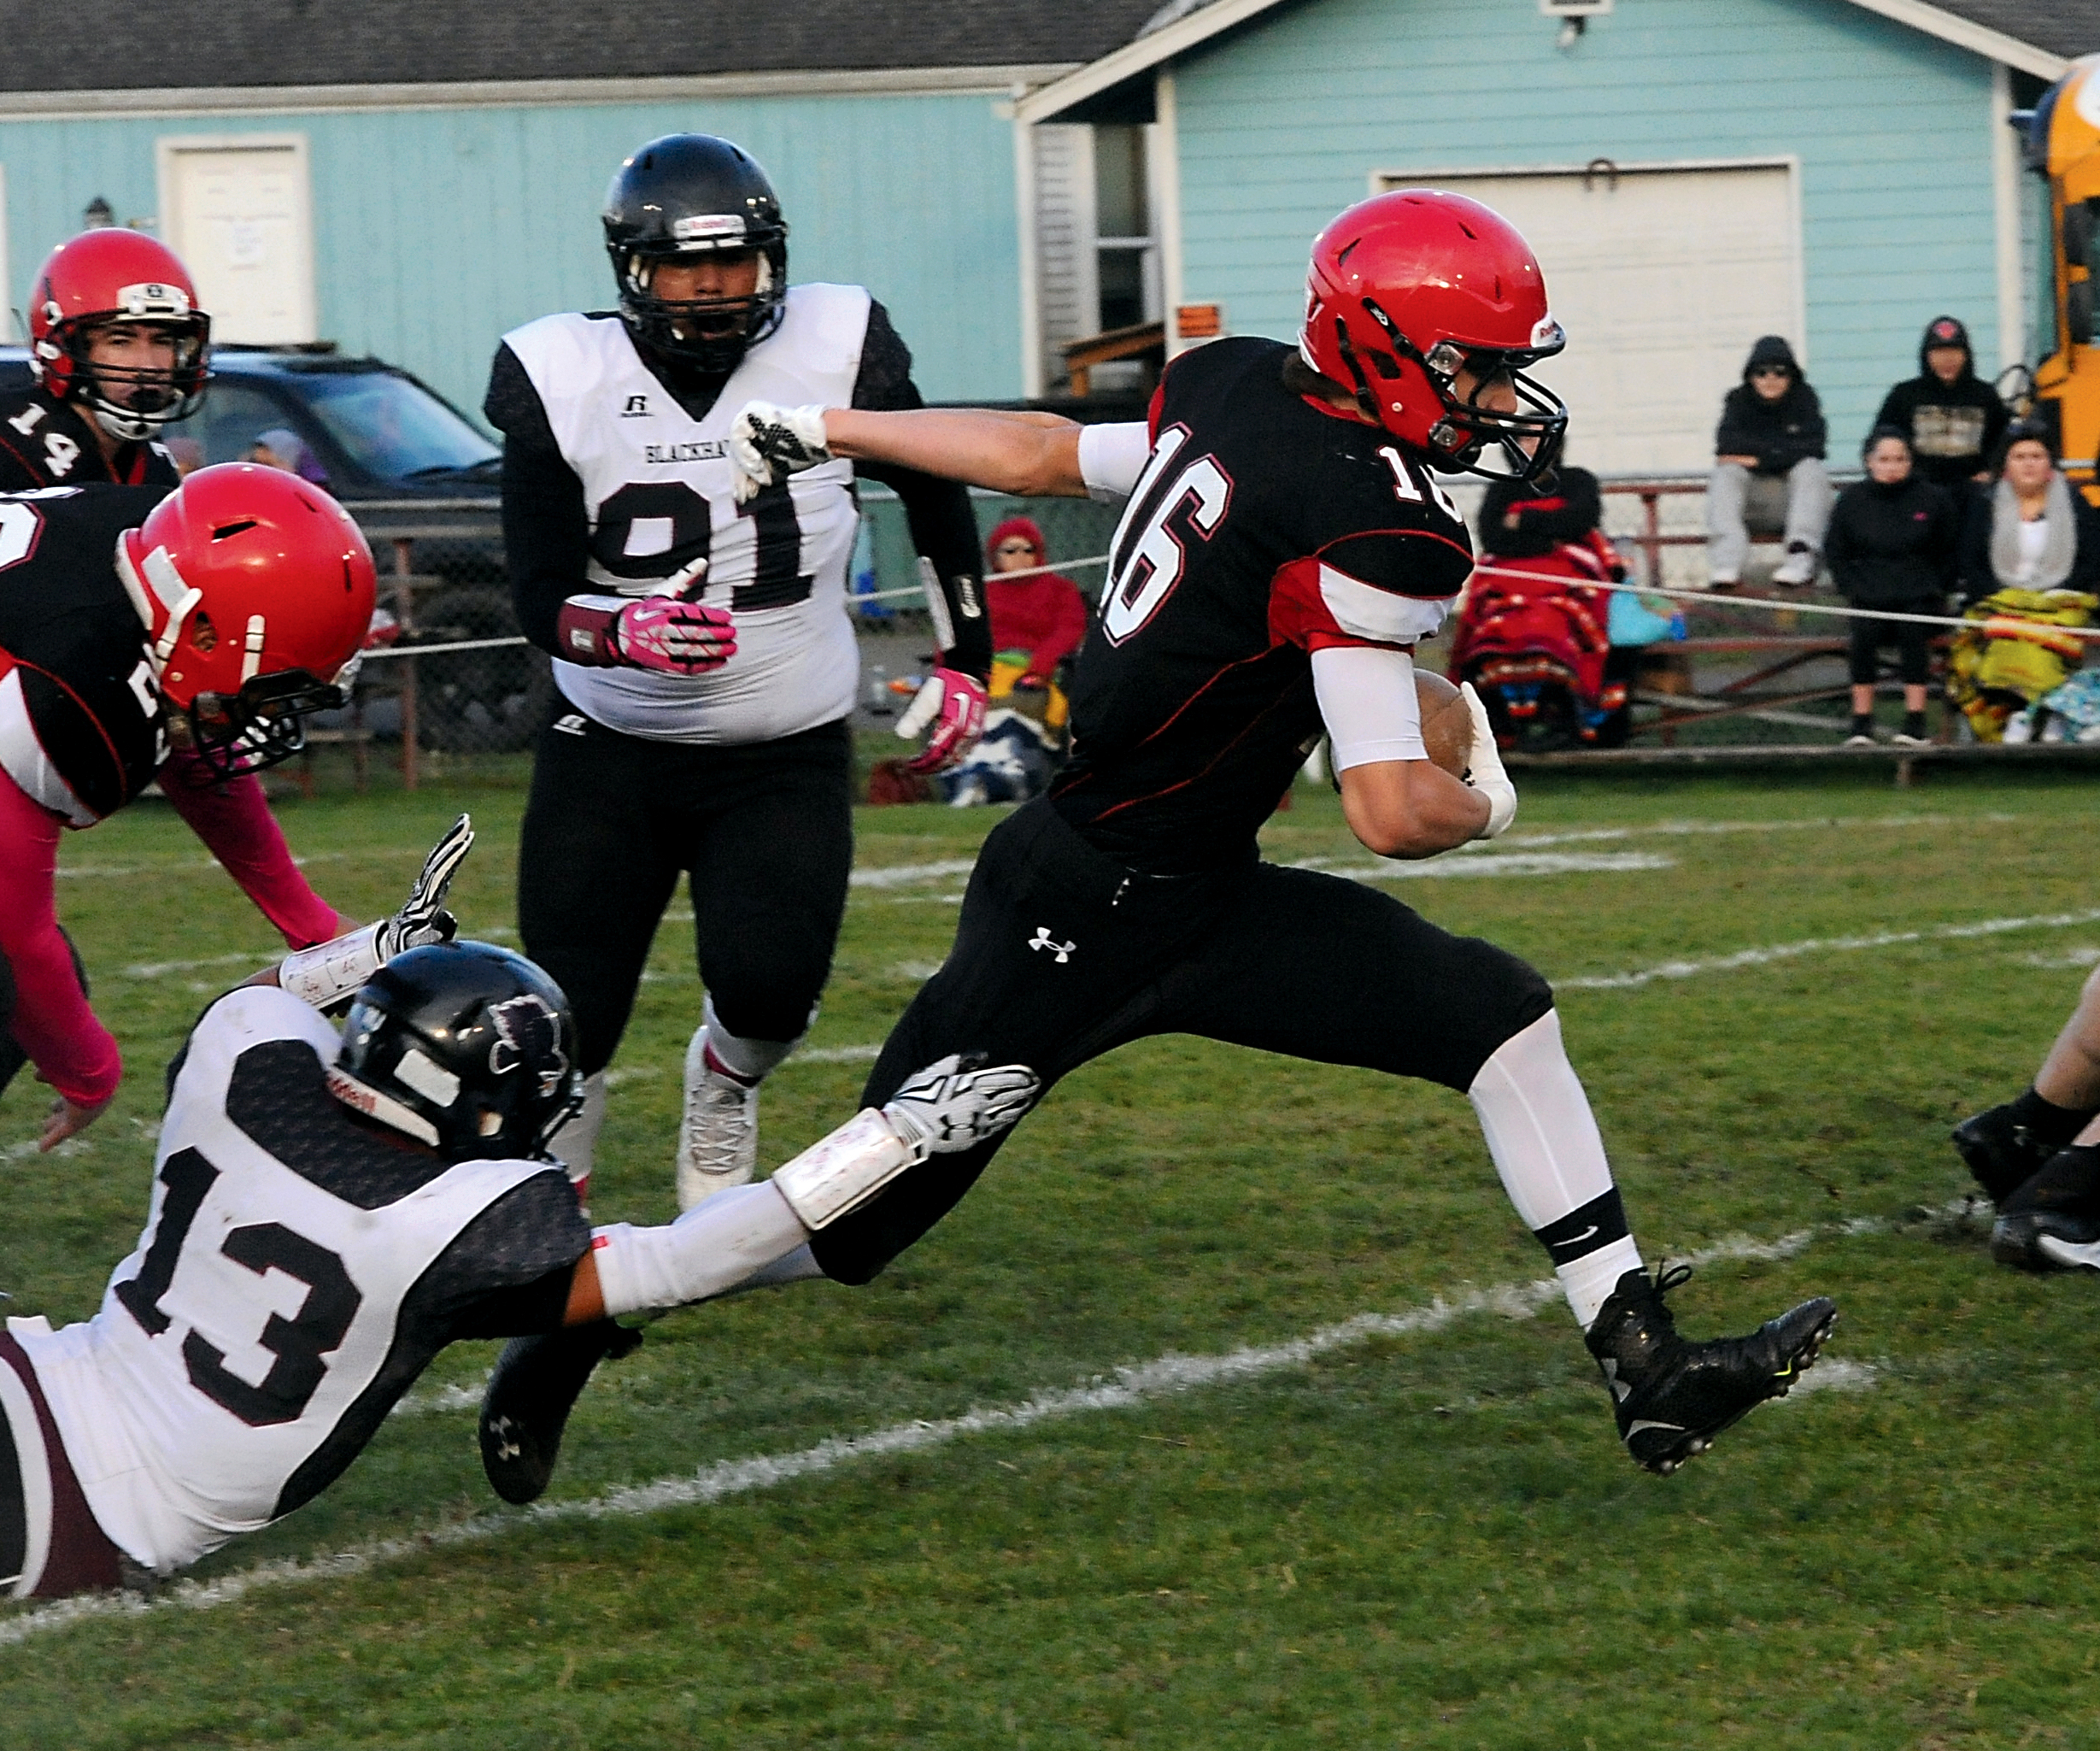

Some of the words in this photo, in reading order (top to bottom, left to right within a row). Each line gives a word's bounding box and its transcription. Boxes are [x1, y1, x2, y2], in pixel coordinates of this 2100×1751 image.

[8, 402, 81, 477] 14
[645, 439, 730, 463] BLACKHA
[590, 481, 814, 612] 91
[1096, 421, 1235, 648] 16
[114, 1145, 363, 1427] 13
